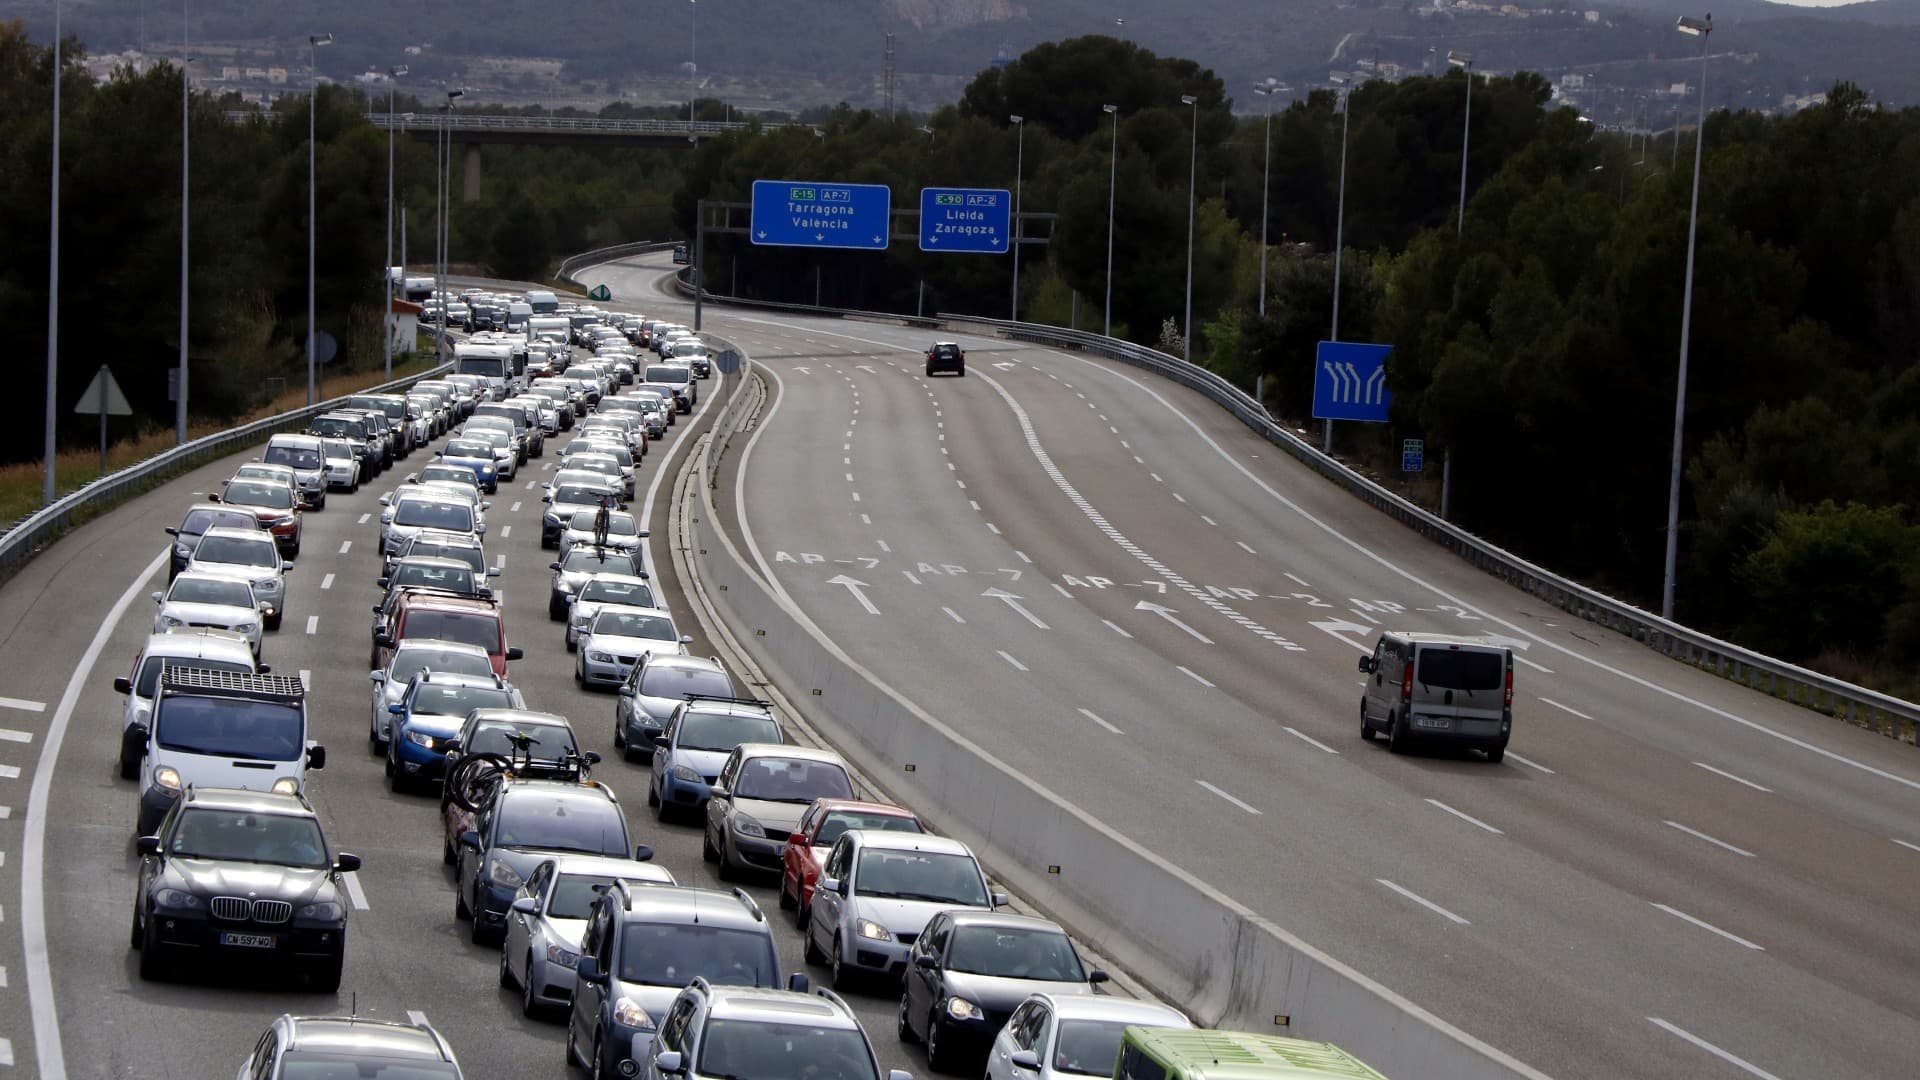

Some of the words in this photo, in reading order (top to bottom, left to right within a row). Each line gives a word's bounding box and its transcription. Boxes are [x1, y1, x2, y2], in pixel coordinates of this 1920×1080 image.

[792, 190, 814, 199] E-15
[823, 191, 848, 200] AP-7
[937, 195, 962, 204] E-90
[968, 196, 995, 205] AP-2
[788, 202, 854, 216] Tarragona
[946, 209, 984, 220] Lleida
[935, 223, 995, 237] Zaragoza
